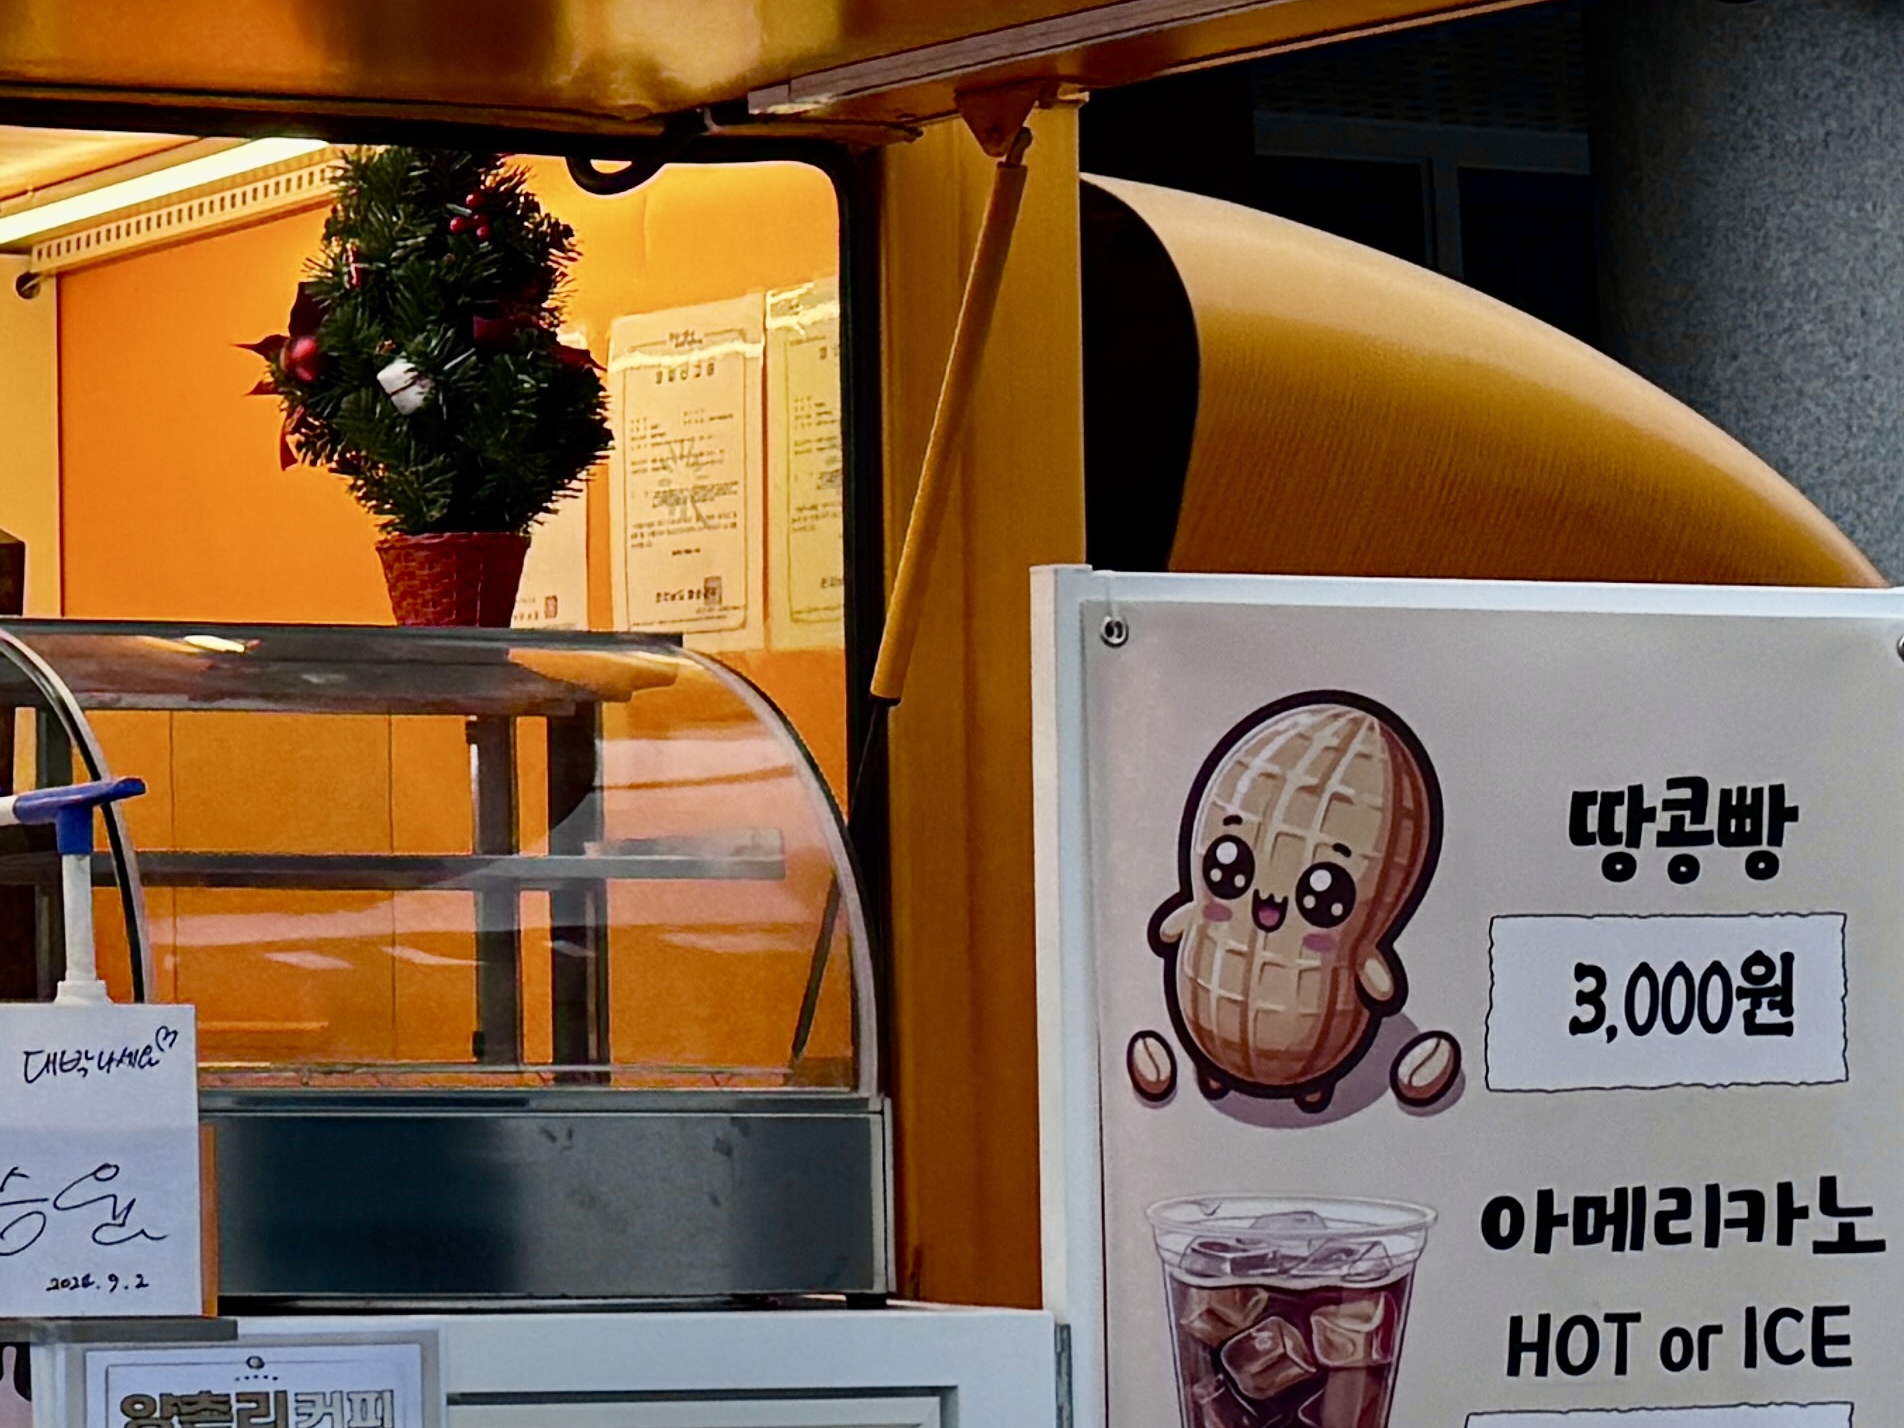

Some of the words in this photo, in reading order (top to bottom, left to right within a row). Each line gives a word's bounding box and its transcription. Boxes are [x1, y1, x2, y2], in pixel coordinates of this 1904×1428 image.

[1568, 775, 1800, 884] 땅콩빵
[1568, 949, 1796, 1045] 3,000원
[1479, 1174, 1887, 1256] 아메리카노
[1506, 1313, 1643, 1379] HOT
[1658, 1324, 1724, 1373] or
[1742, 1305, 1853, 1371] ICE
